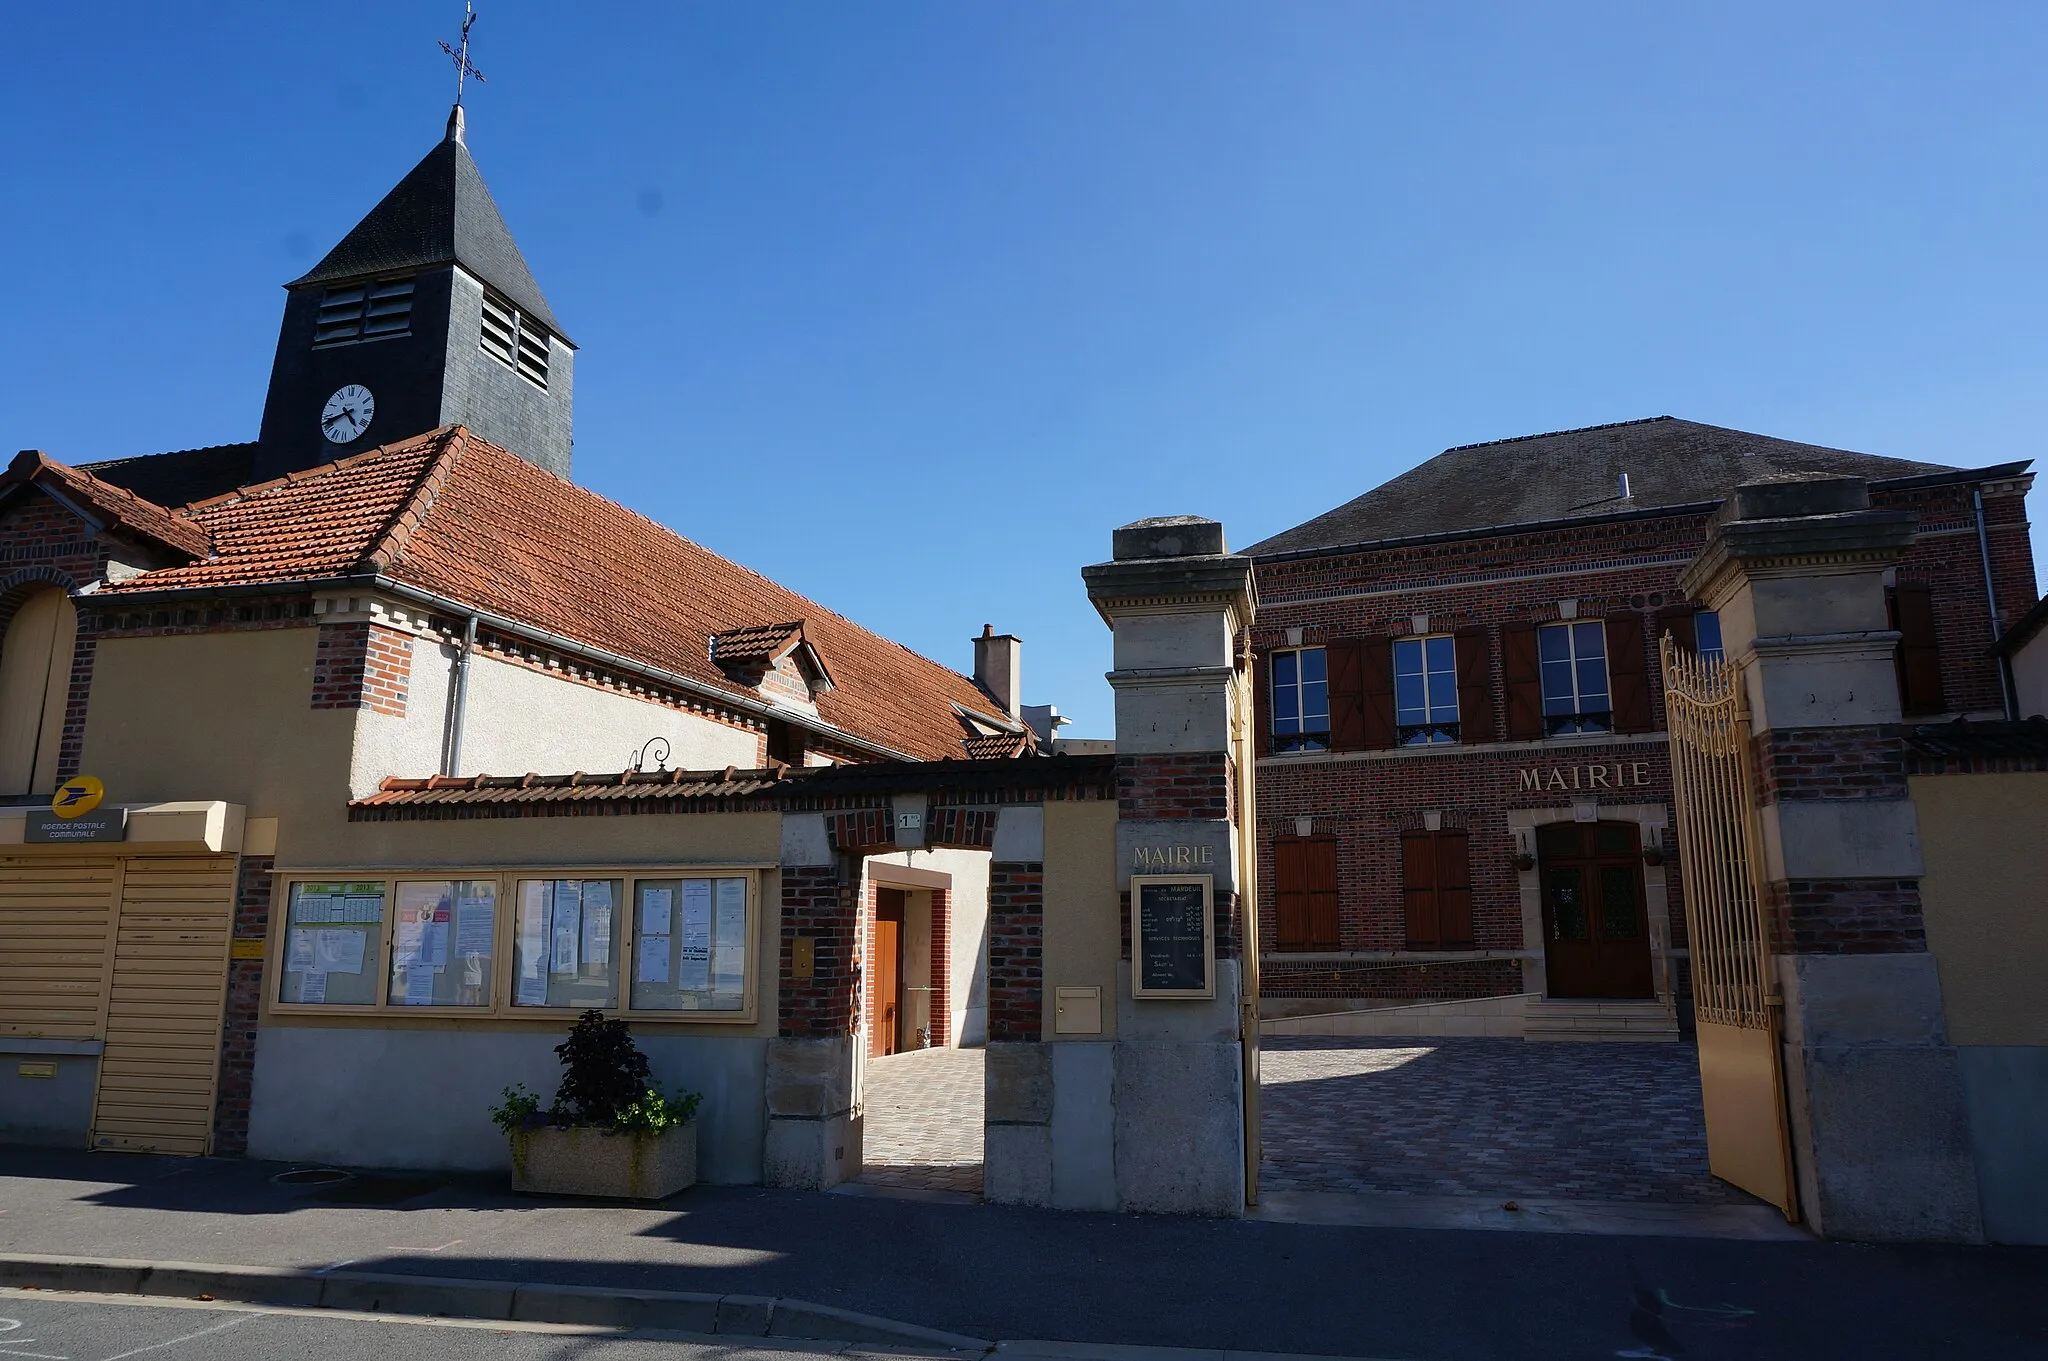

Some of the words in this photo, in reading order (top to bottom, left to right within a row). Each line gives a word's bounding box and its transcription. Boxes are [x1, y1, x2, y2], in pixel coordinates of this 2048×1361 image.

[1518, 762, 1652, 792] MAIRIE
[902, 815, 908, 826] 1
[49, 830, 96, 838] COMMUNALE
[1134, 846, 1214, 864] MAIRIE
